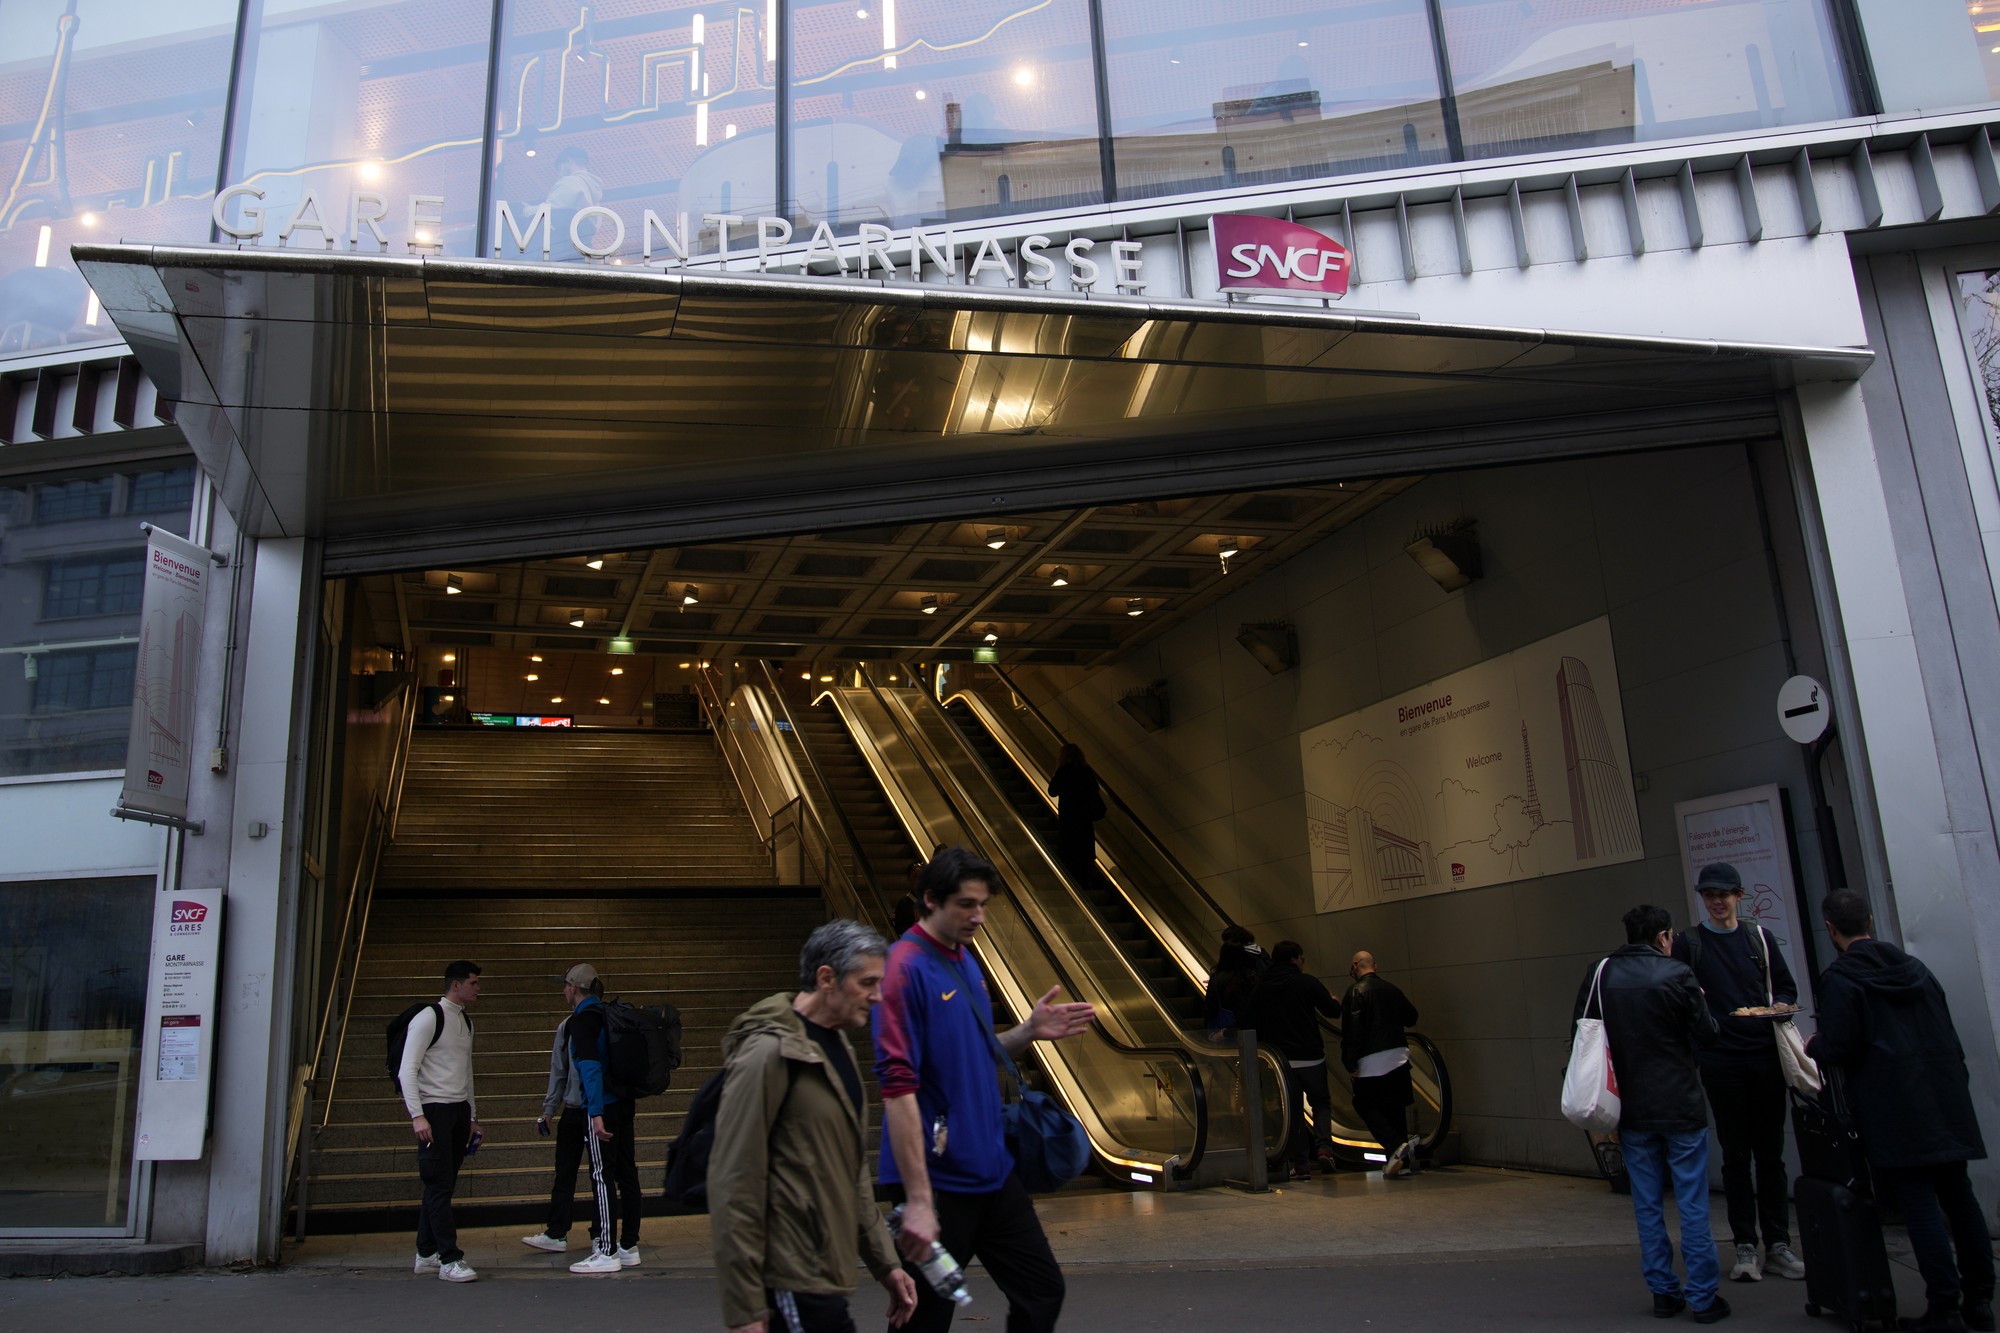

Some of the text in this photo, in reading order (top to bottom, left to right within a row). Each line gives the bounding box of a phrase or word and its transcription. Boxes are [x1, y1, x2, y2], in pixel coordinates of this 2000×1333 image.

[212, 184, 1146, 289] GARE MONTPARNASSE
[1227, 243, 1345, 283] SNCF
[153, 563, 172, 575] Welcome
[154, 550, 200, 578] Bienvenue
[1398, 694, 1452, 723] Bienvenue
[1400, 700, 1490, 736] en gare de Paris Montparnasse
[1466, 752, 1502, 769] Welcome
[1689, 824, 1750, 841] Faisons de l'énergie
[1690, 843, 1704, 852] avec
[1705, 840, 1717, 849] des
[173, 908, 205, 921] SNCF
[170, 924, 202, 932] GARES
